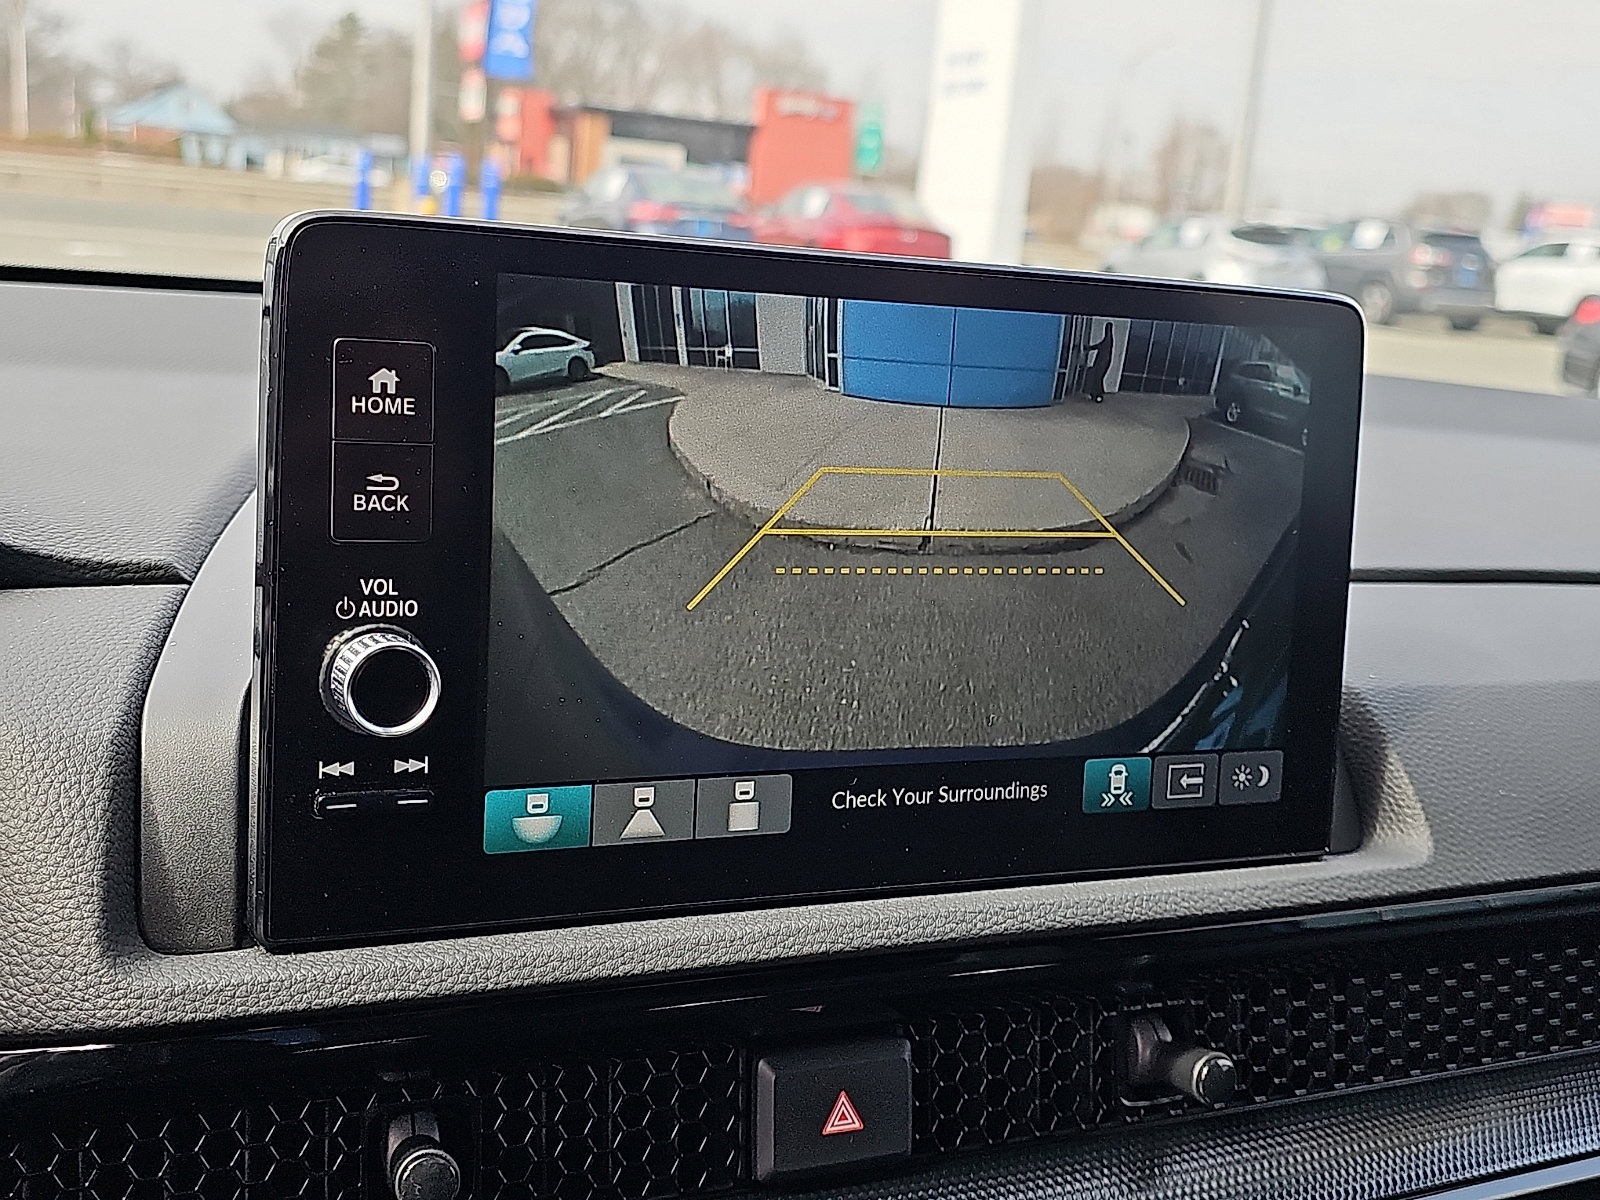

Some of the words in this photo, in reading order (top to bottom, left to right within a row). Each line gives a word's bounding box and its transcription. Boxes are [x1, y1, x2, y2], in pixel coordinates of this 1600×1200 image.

[351, 395, 416, 416] HOME
[353, 494, 410, 512] BACK
[359, 578, 399, 596] VOL
[358, 599, 419, 618] AUDIO
[831, 790, 887, 810] Check
[891, 787, 933, 806] Your
[938, 781, 1049, 804] Surroundings
